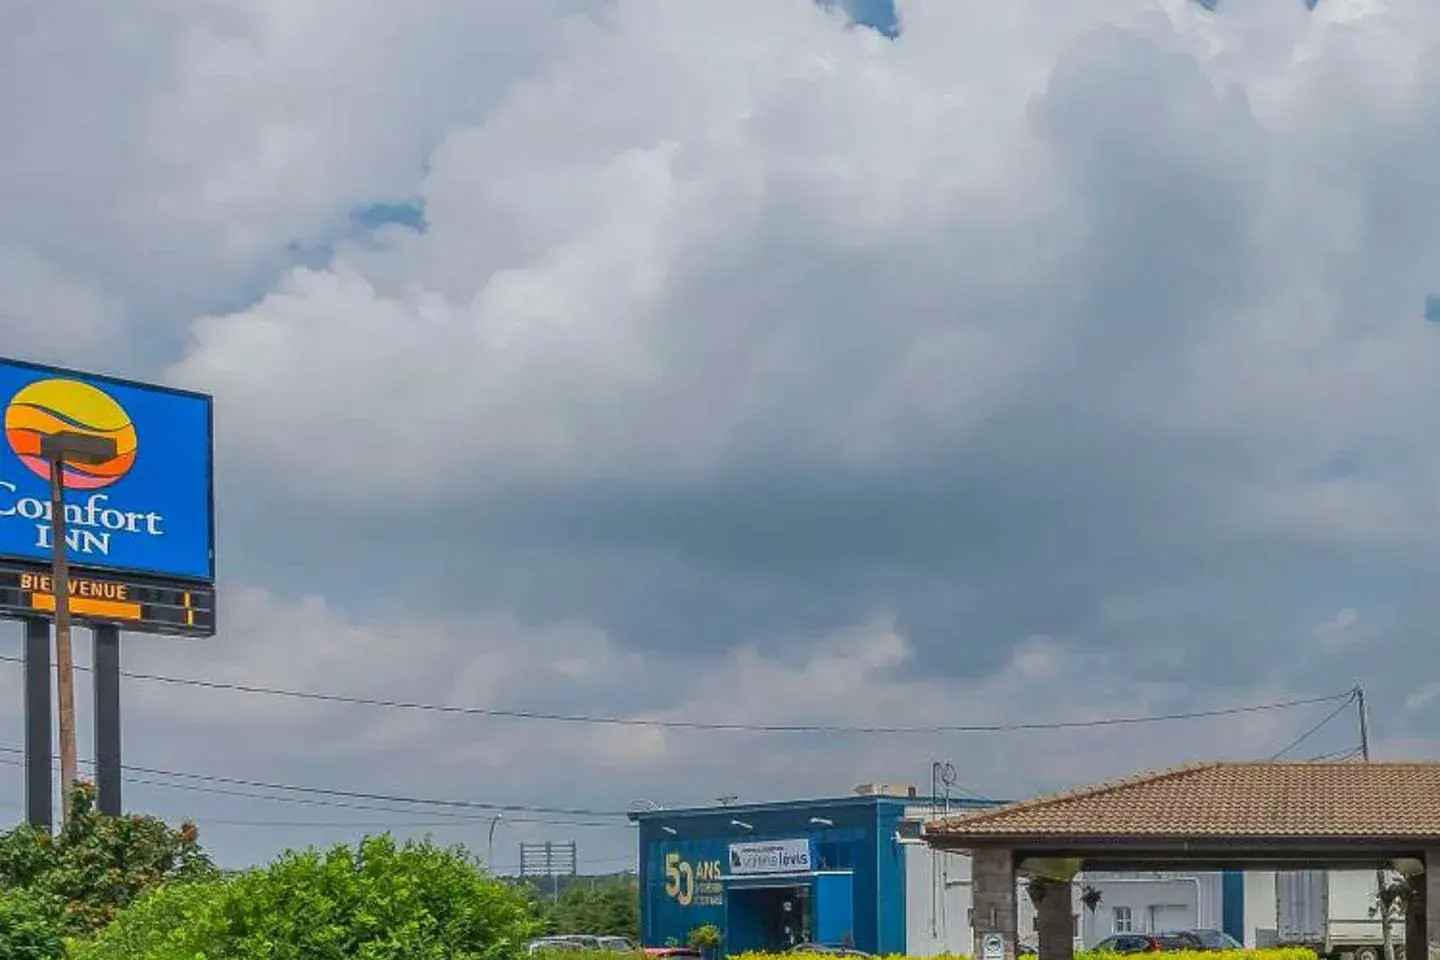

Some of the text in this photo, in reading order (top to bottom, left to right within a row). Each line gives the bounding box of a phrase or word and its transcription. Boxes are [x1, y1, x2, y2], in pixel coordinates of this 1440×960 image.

[20, 573, 127, 600] BIEVENUE
[665, 852, 721, 905] 50 ANS
